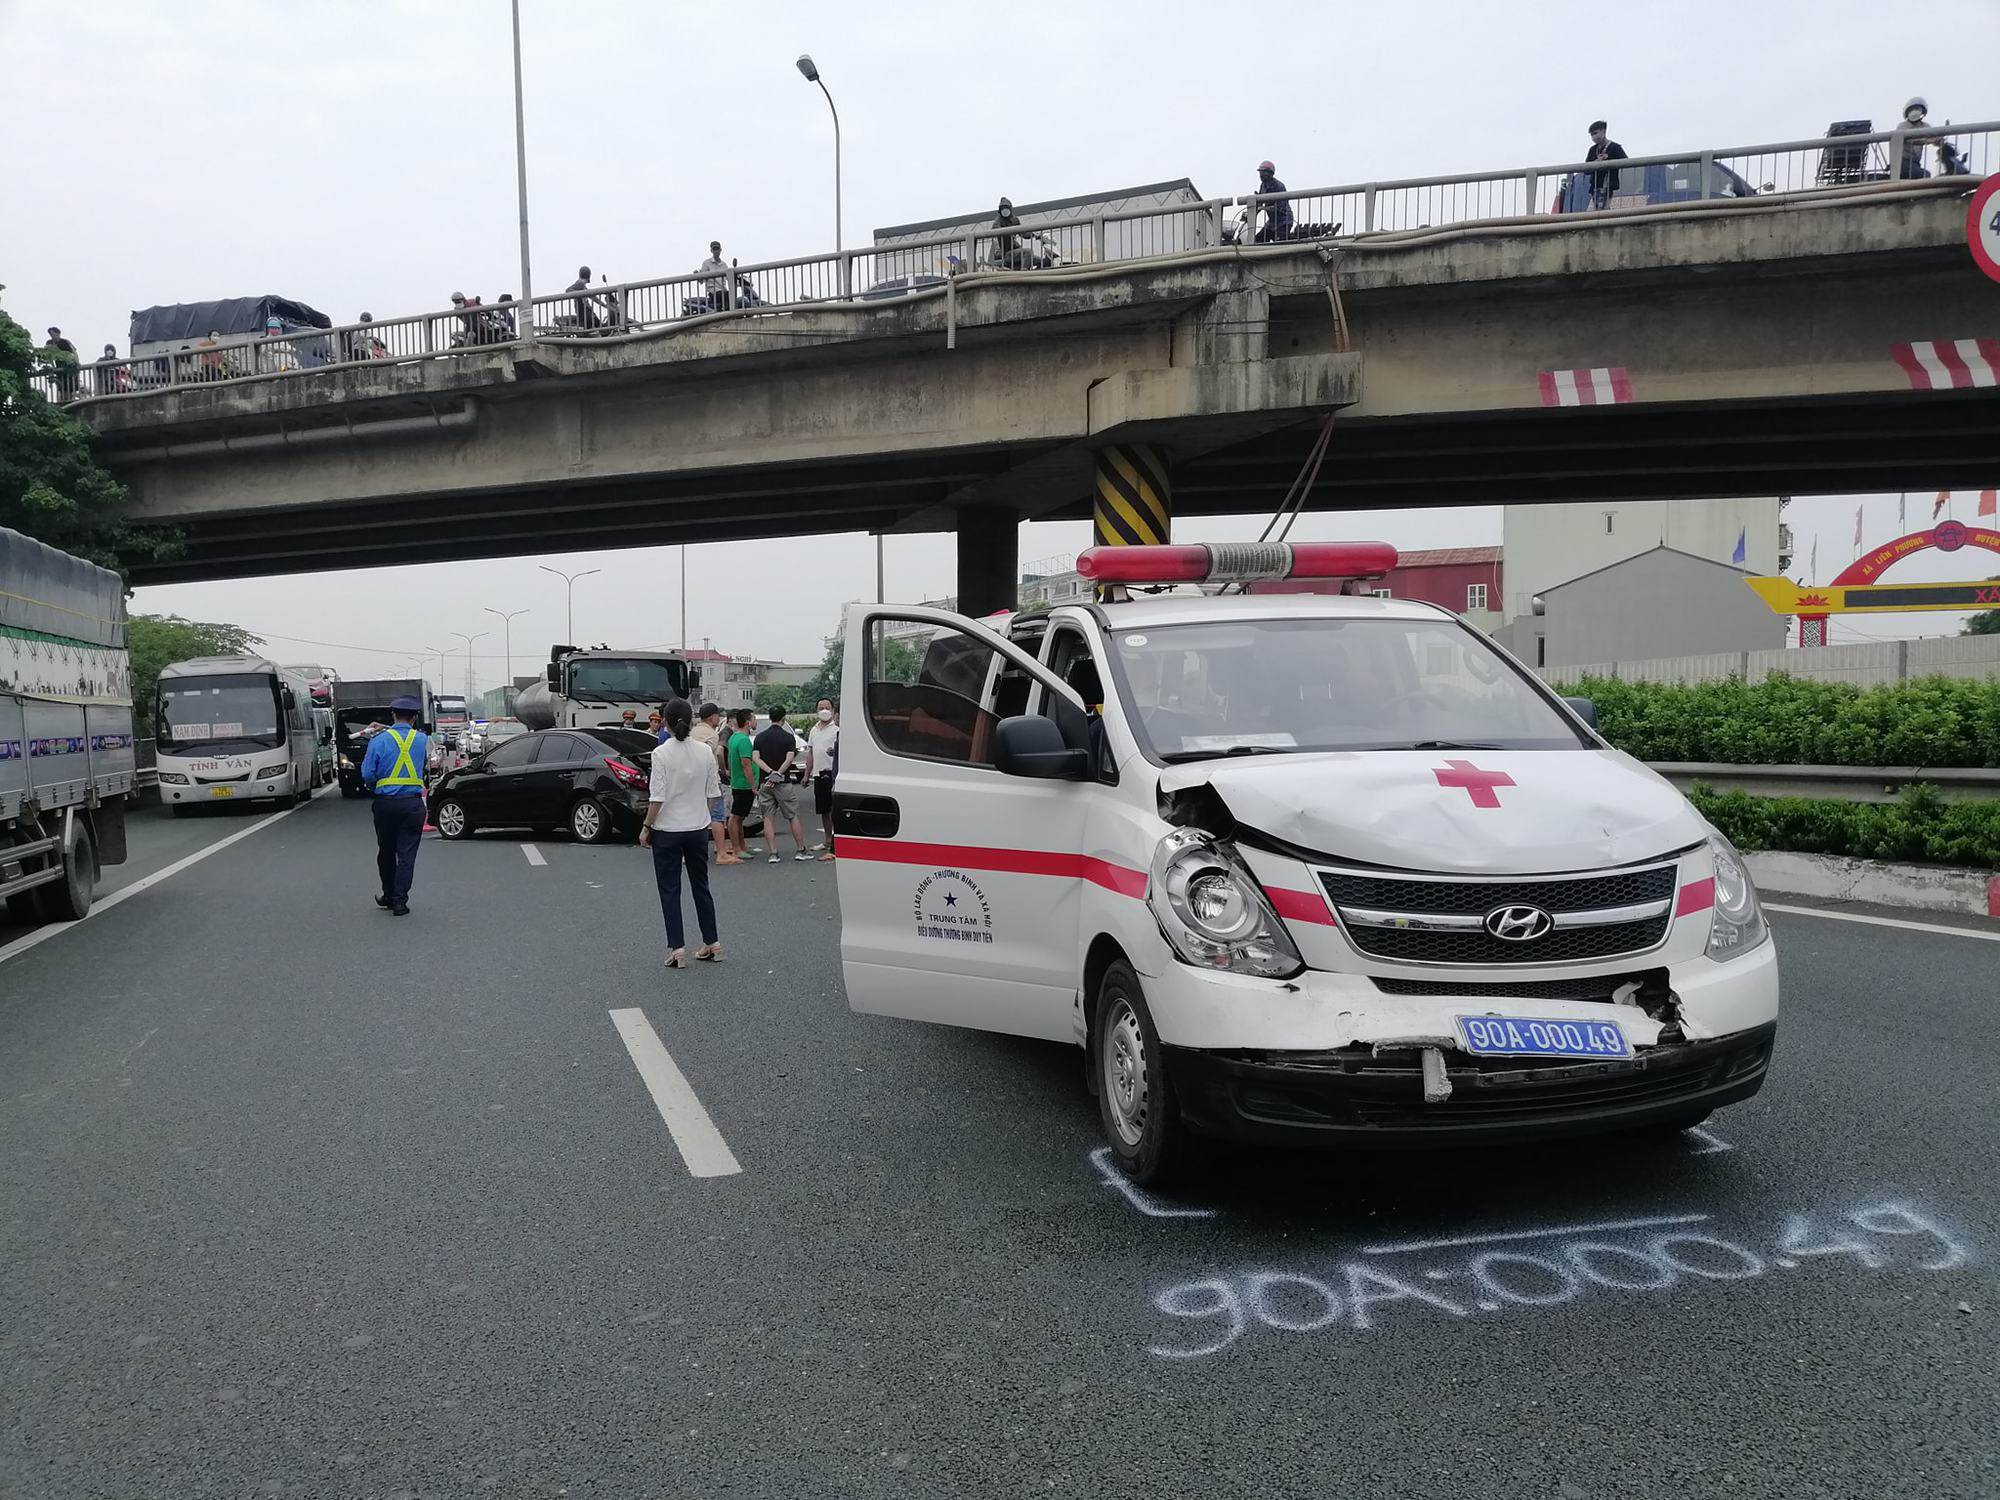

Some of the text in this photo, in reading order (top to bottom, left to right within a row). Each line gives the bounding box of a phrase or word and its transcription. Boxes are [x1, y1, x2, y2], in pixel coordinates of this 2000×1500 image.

[174, 725, 190, 739] NAM
[914, 894, 922, 909] LAO
[961, 874, 978, 891] BINH
[929, 914, 978, 925] TRUNG TÂM
[943, 927, 961, 940] THƯƠNG
[961, 930, 972, 941] BINH
[973, 931, 982, 942] DUY
[1468, 1021, 1622, 1052] 90A-000.49
